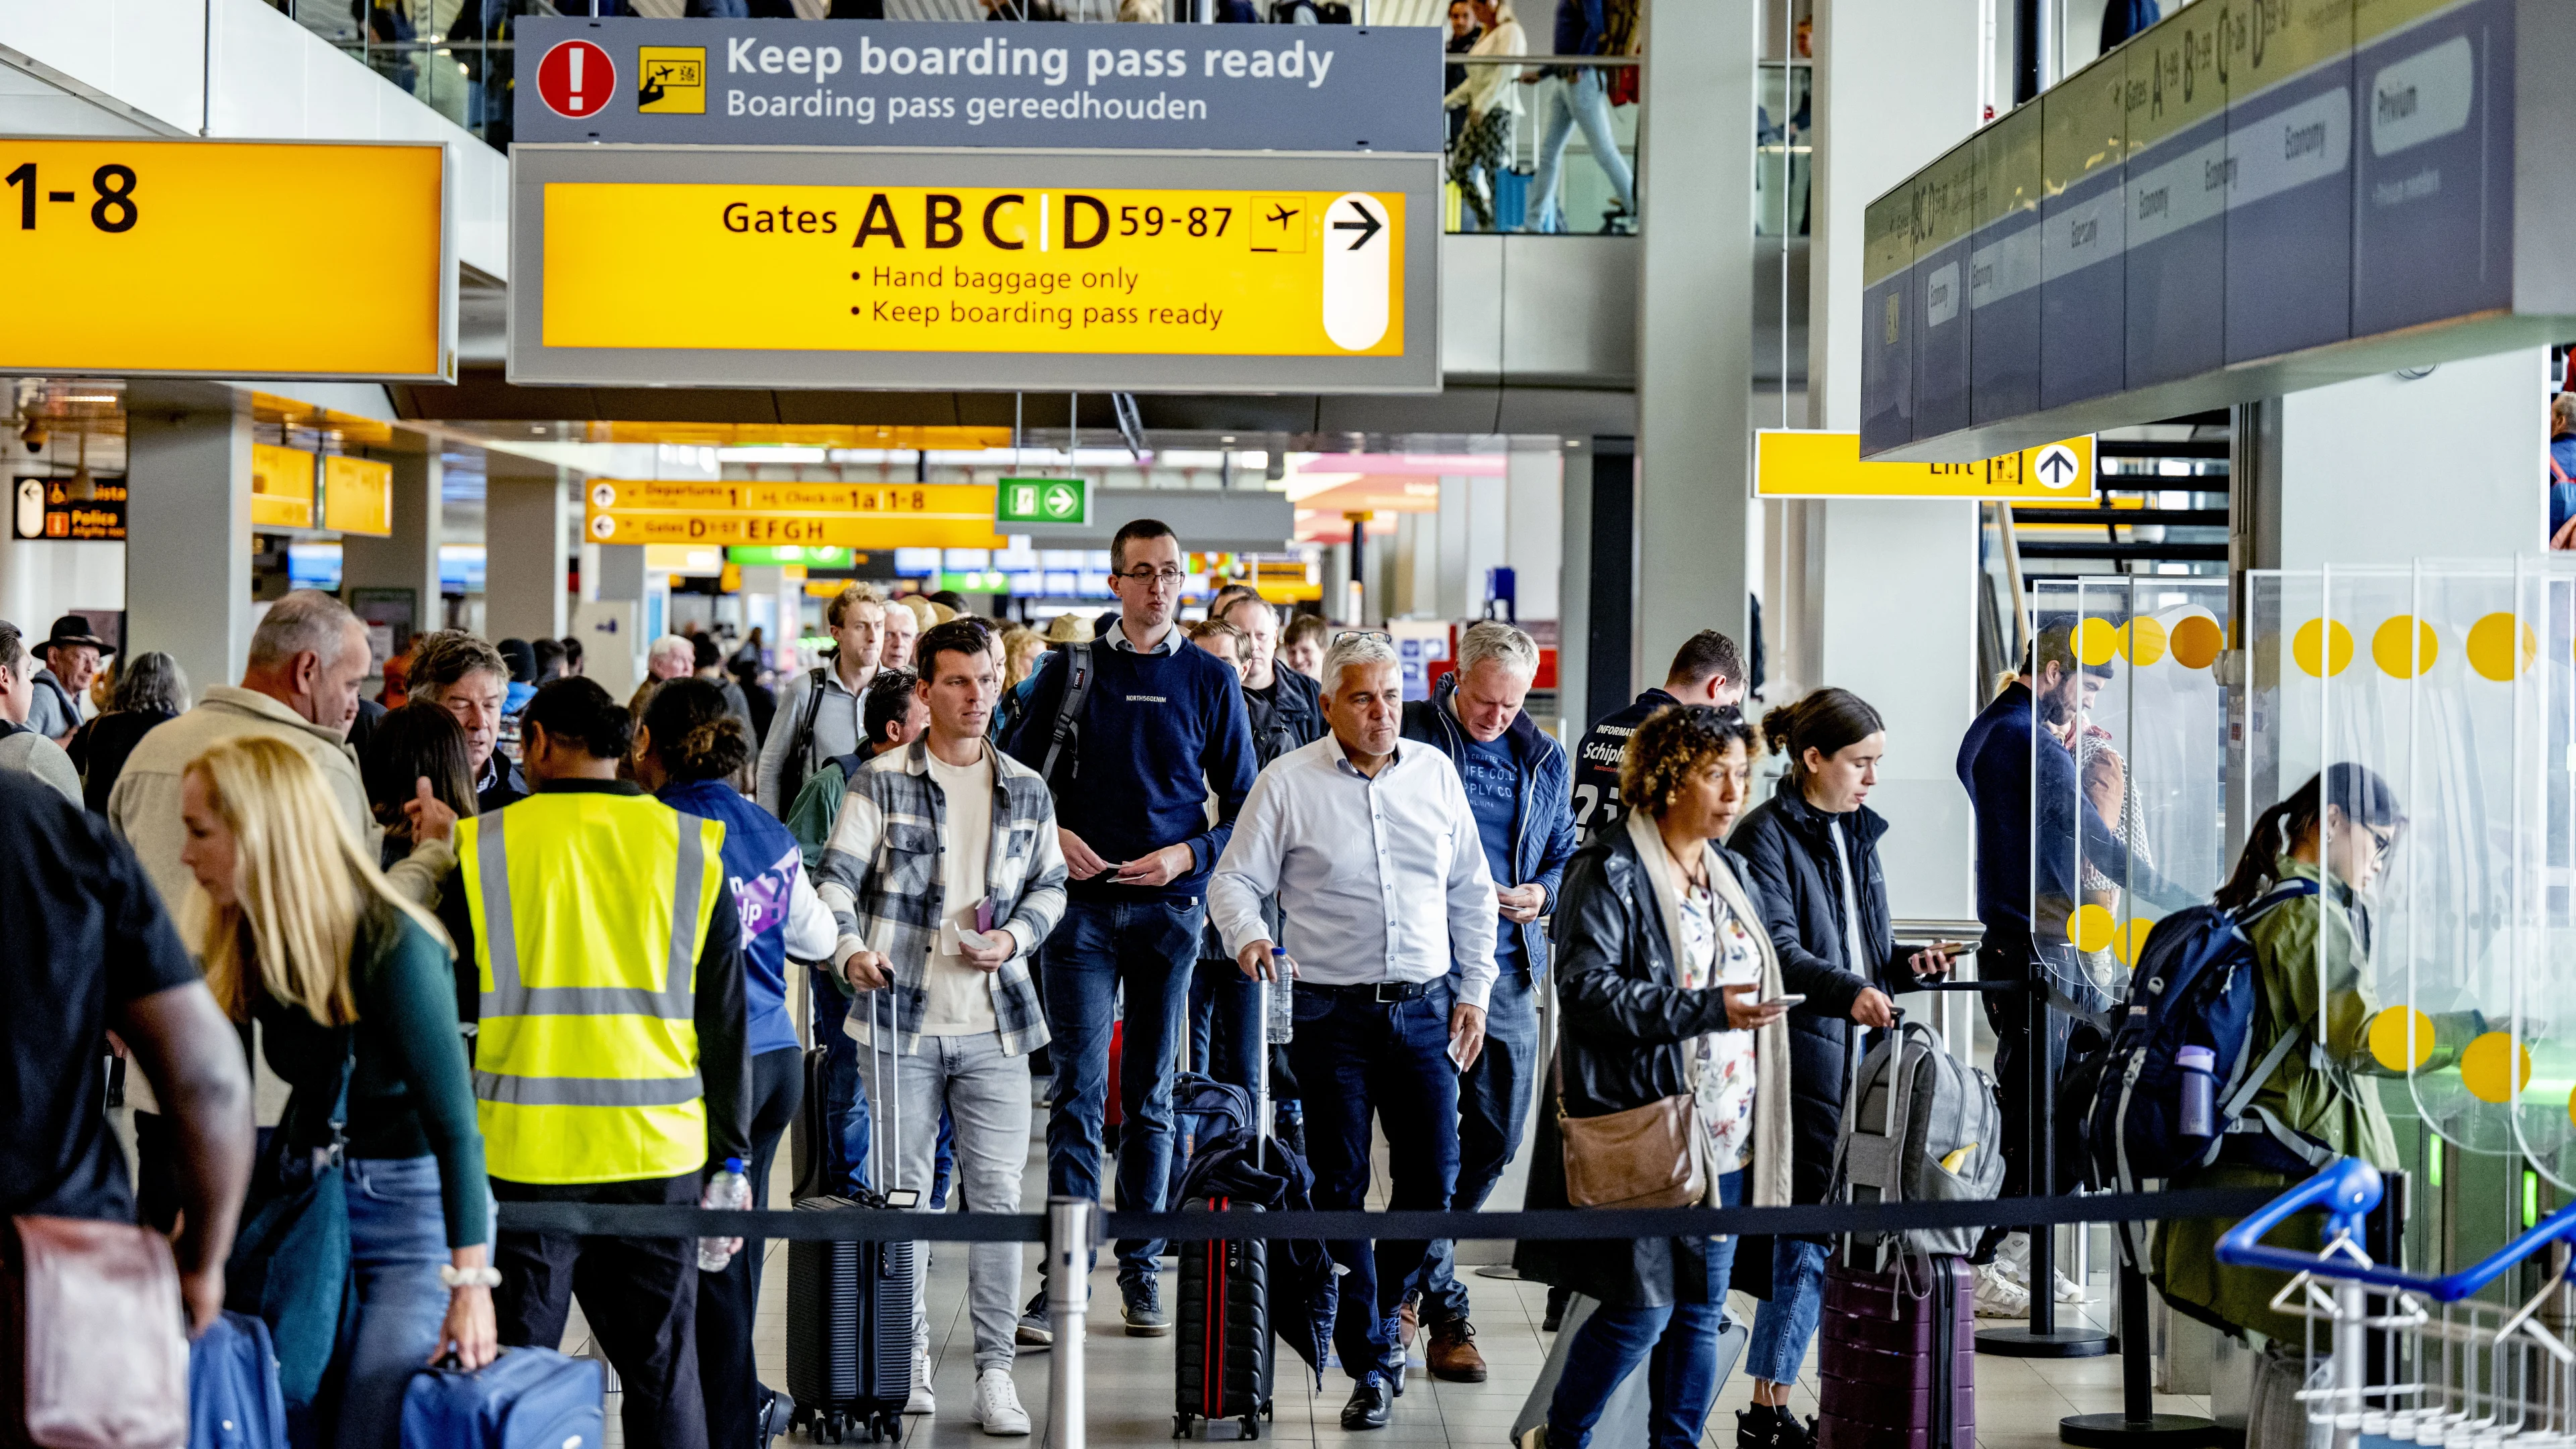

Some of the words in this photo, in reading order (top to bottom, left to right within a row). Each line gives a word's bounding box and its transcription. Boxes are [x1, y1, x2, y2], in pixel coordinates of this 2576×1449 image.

[729, 38, 842, 83] Keep
[861, 36, 1067, 85] boarding
[1088, 49, 1186, 85] pass
[1205, 40, 1334, 89] ready
[728, 90, 875, 123] Boarding
[889, 97, 955, 124] pass
[967, 91, 1206, 125] gereedhouden
[5, 163, 138, 233] 1-8
[724, 203, 837, 233] Gates
[853, 194, 905, 249] A
[926, 195, 963, 249] B
[983, 195, 1024, 250] C
[1064, 195, 1110, 250] D
[1121, 207, 1232, 237] 59-87
[874, 266, 942, 287] Hand
[955, 266, 1071, 294] baggage
[1083, 267, 1138, 294] only
[874, 301, 940, 327] Keep
[952, 301, 1071, 329] boarding
[1084, 307, 1138, 329] pass
[1150, 303, 1223, 330] ready
[71, 509, 118, 527] Police
[688, 519, 706, 539] D
[748, 519, 761, 539] E
[767, 520, 779, 539] F
[784, 519, 800, 539] G
[807, 521, 823, 539] H
[1126, 695, 1167, 703] NORTH56DENIM
[1597, 724, 1638, 737] INFORMAT
[1471, 753, 1498, 763] CRAFTED
[1583, 742, 1625, 765] Schiph
[1466, 765, 1485, 777] IFE
[1489, 768, 1515, 781] CO.L
